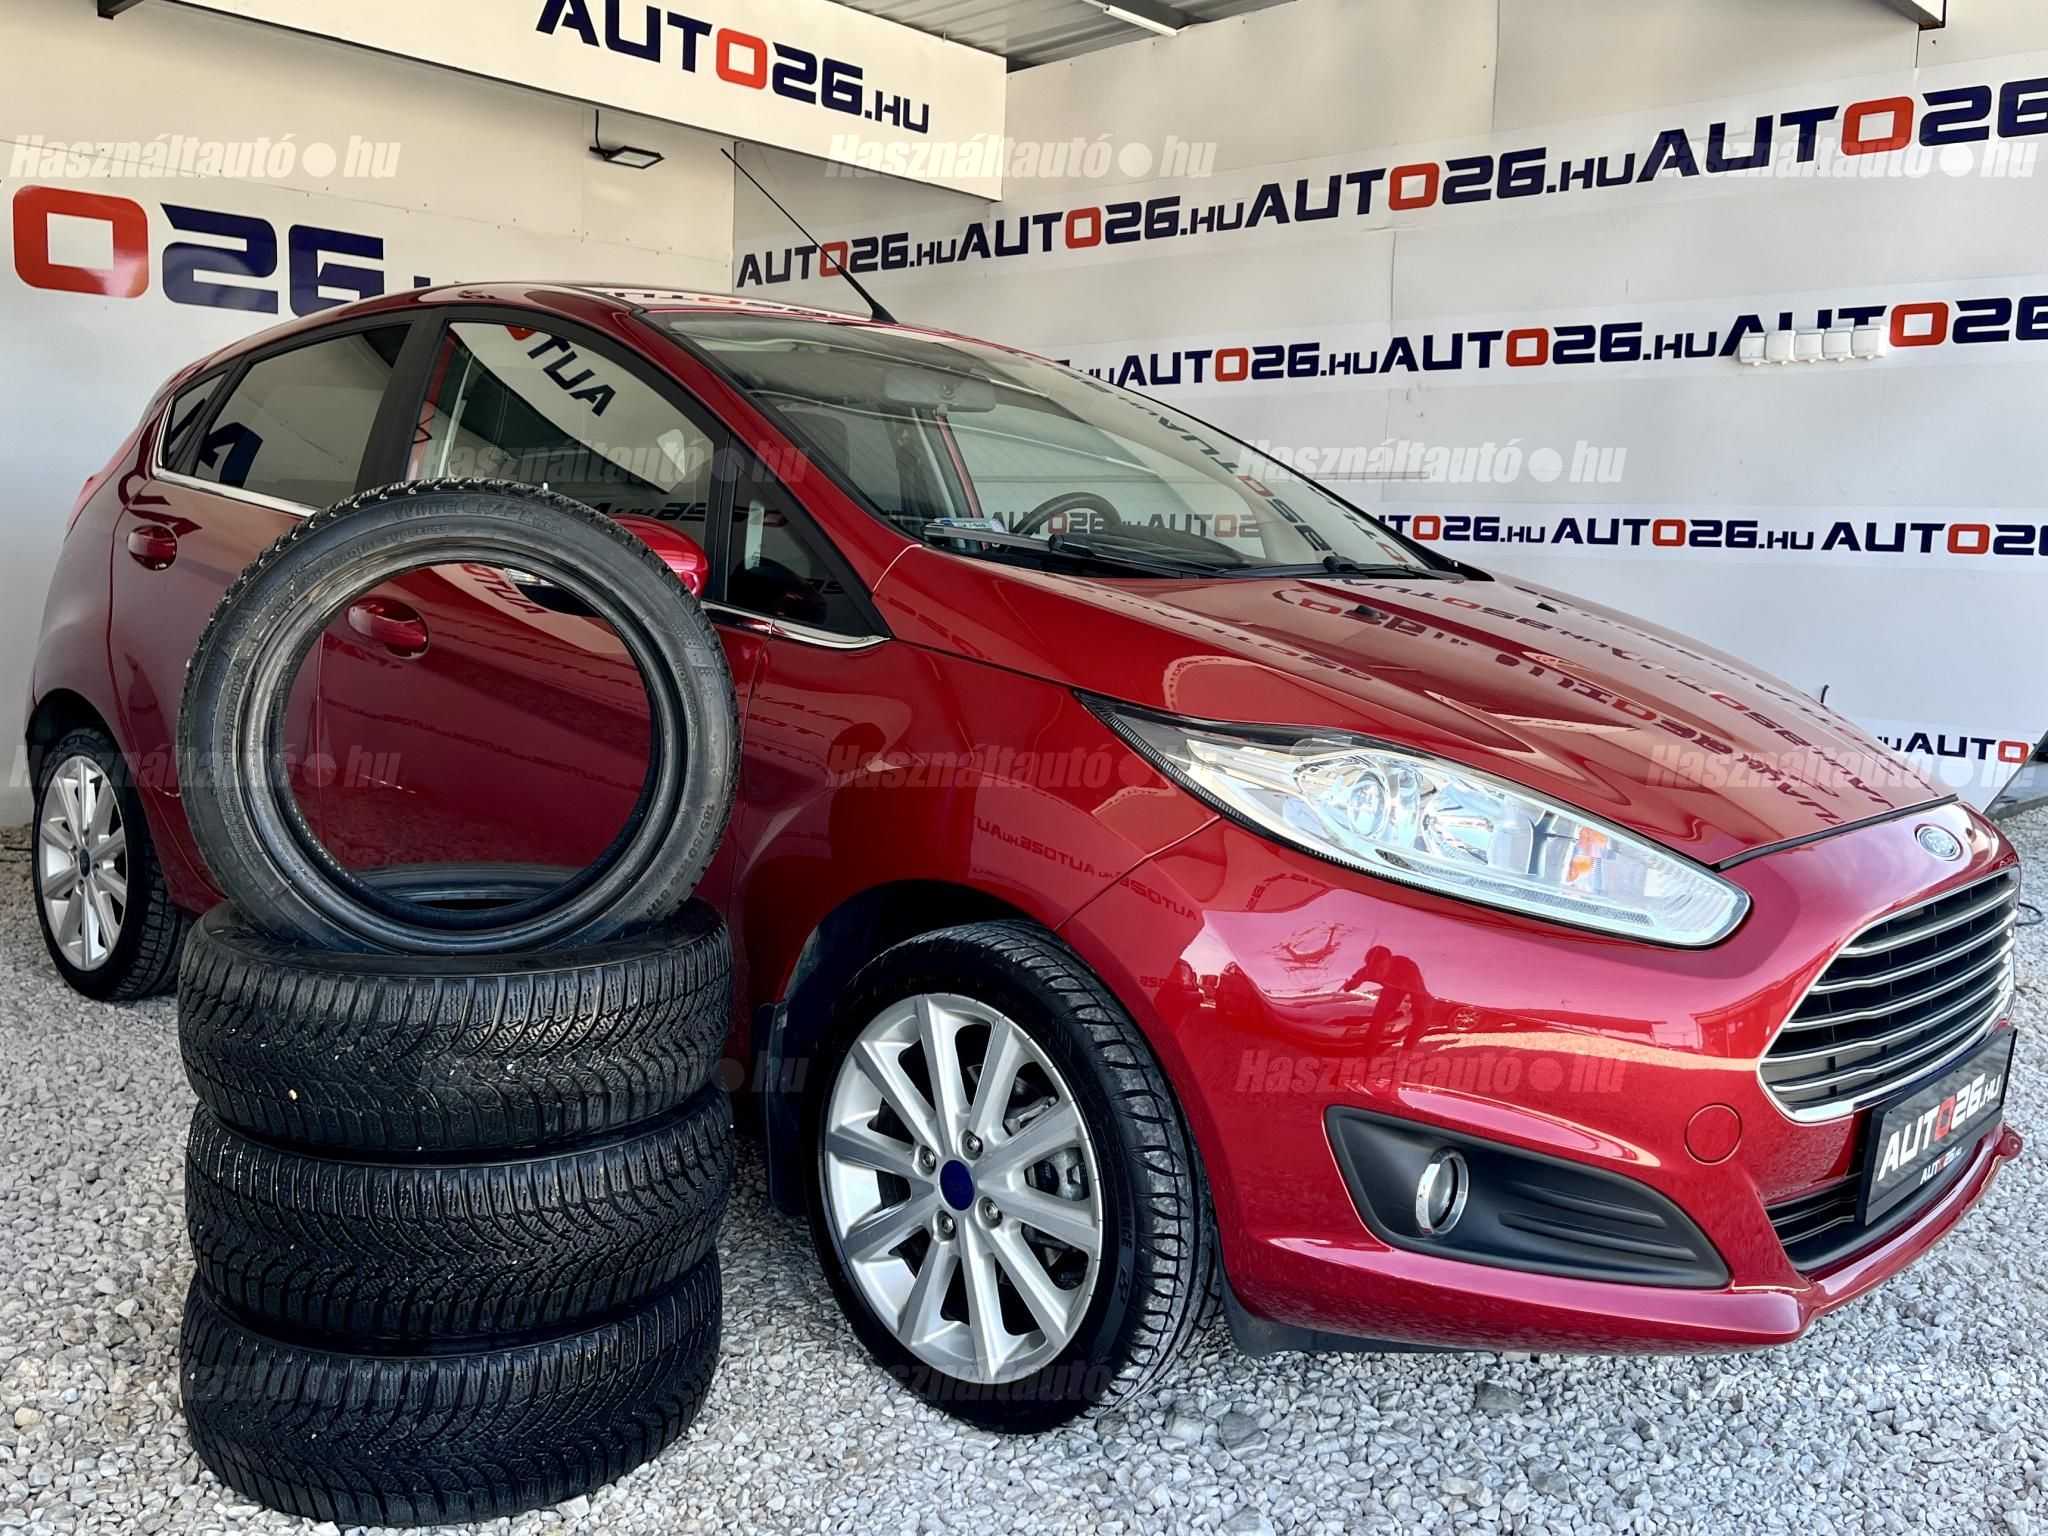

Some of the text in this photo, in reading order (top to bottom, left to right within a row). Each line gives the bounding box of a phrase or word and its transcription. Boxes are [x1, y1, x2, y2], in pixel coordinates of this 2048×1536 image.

[536, 0, 929, 134] AUTO26.HU
[737, 232, 957, 288] AUTO26.HU
[957, 196, 1245, 262] AUTO26.HU
[1245, 147, 1636, 228] AUTO26.HU
[1116, 343, 1377, 388] AUTO26.HU
[1379, 322, 1717, 374] AUTO26.HU
[1377, 514, 2048, 557] TO26.HU AUTO26.HU AUTO2
[1904, 732, 2030, 764] AUTO
[1877, 1073, 2002, 1182] AUTO26.HU
